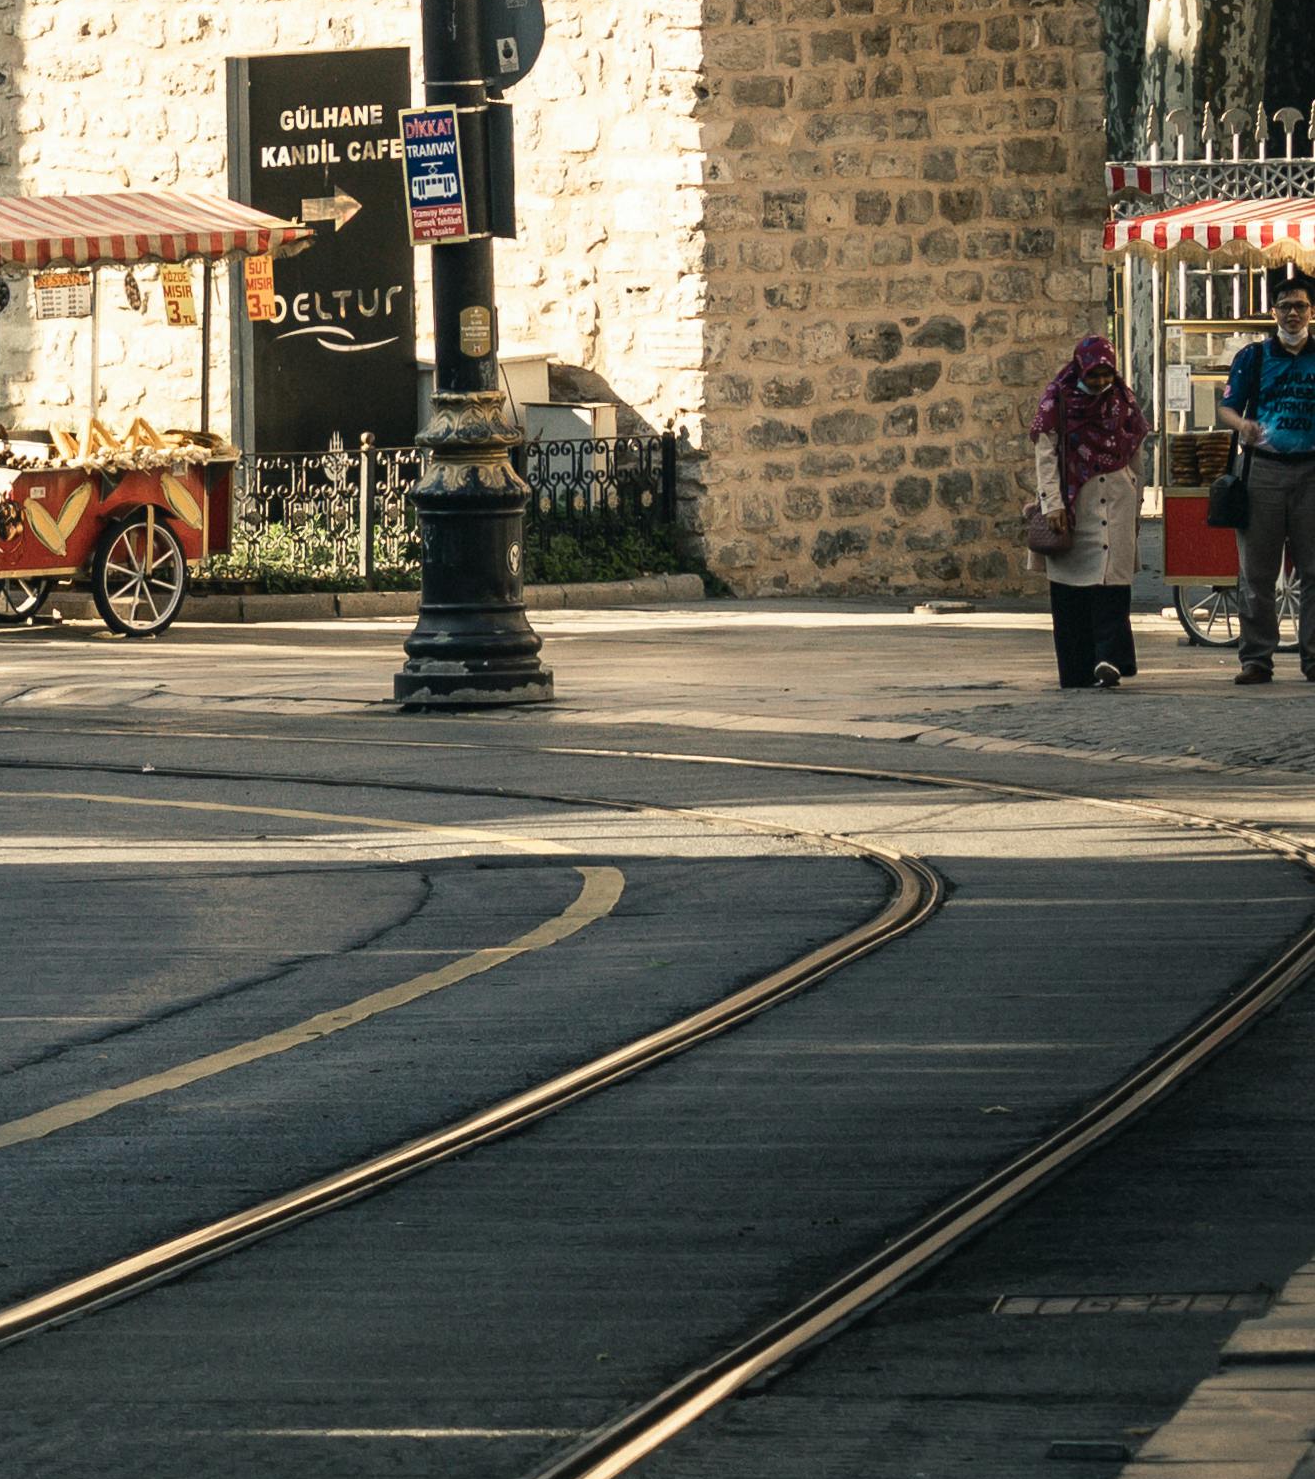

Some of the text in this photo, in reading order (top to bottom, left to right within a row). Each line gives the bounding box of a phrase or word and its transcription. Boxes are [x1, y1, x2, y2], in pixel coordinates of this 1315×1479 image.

[280, 105, 383, 131] GÜLHANE
[405, 118, 453, 139] DİKKAT
[261, 138, 403, 168] KANDİL CAFE
[406, 141, 456, 159] TRAMVAY
[168, 300, 182, 324] 3
[248, 293, 262, 318] 3
